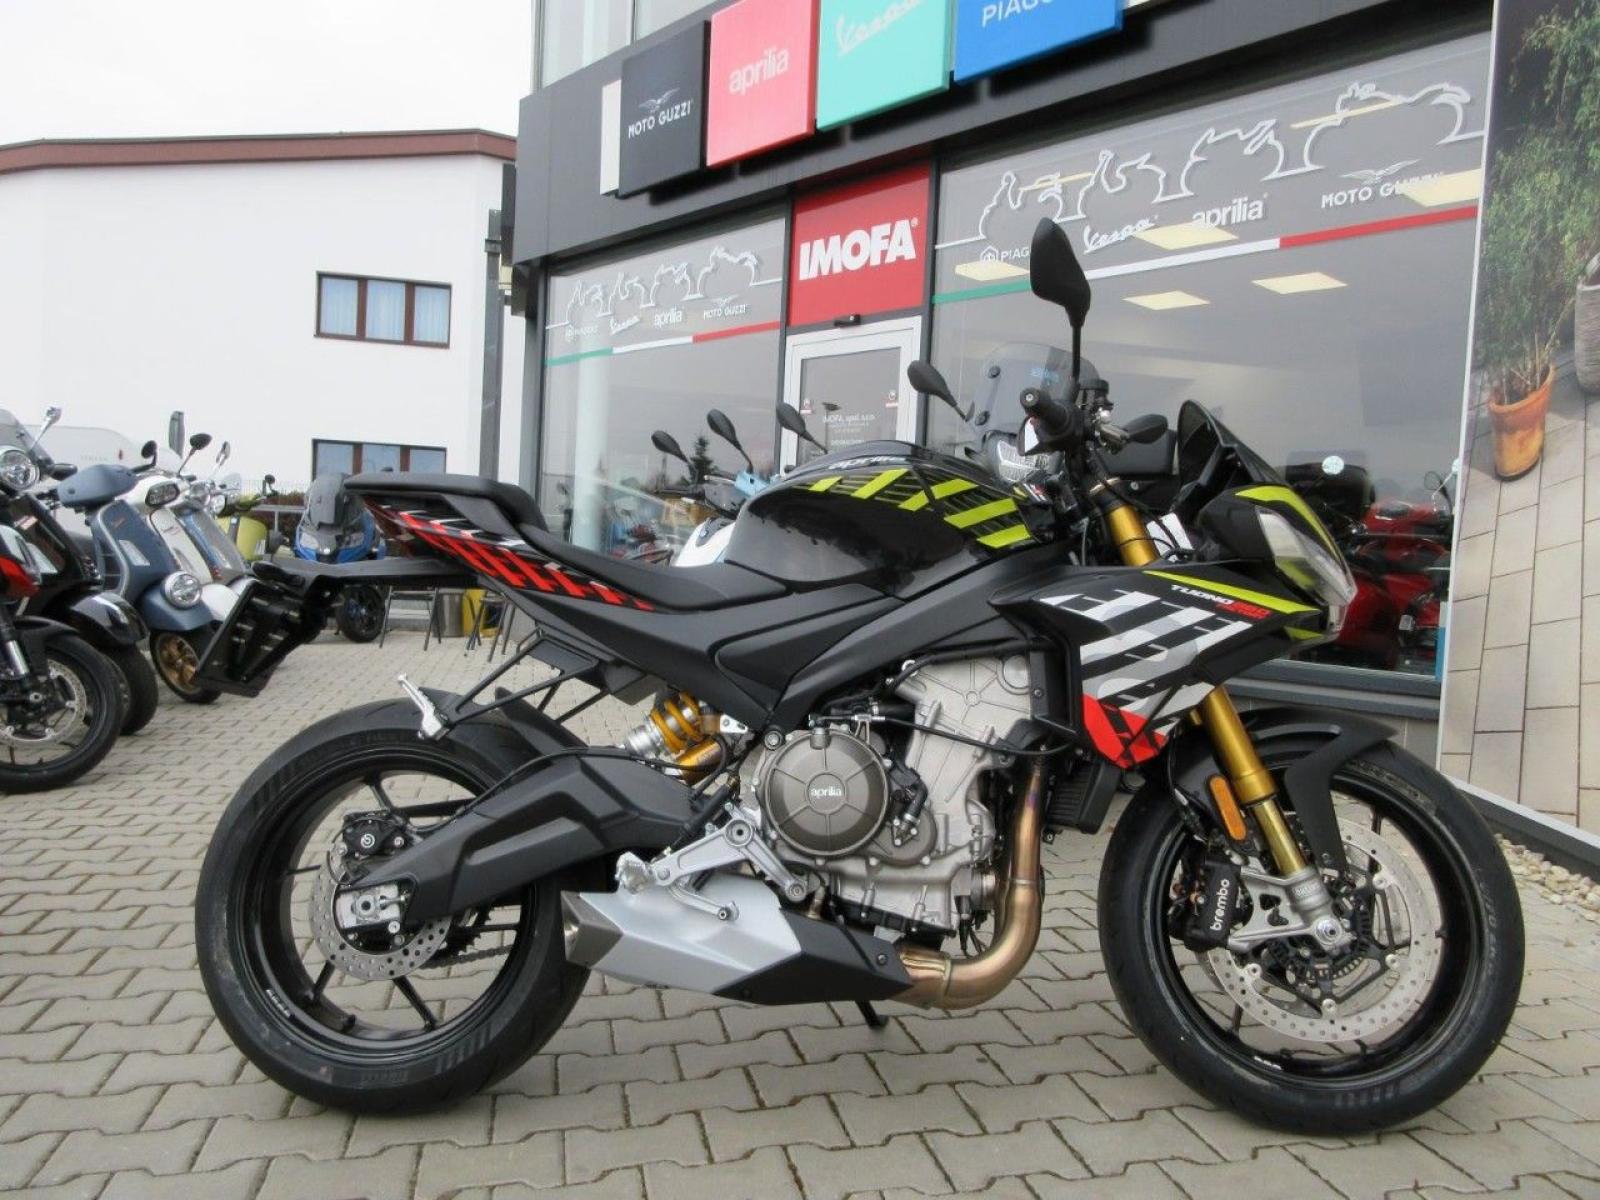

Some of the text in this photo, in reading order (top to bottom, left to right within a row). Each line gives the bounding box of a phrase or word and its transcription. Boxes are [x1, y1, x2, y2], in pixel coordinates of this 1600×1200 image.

[729, 46, 789, 95] aprilia
[628, 100, 692, 139] MOTO GUZZI
[1192, 197, 1265, 228] aprilia
[1321, 186, 1373, 208] MOTO
[799, 219, 917, 281] IMOFA
[1171, 584, 1235, 605] TUONO
[810, 785, 842, 799] aprilia
[1209, 878, 1231, 932] brembo
